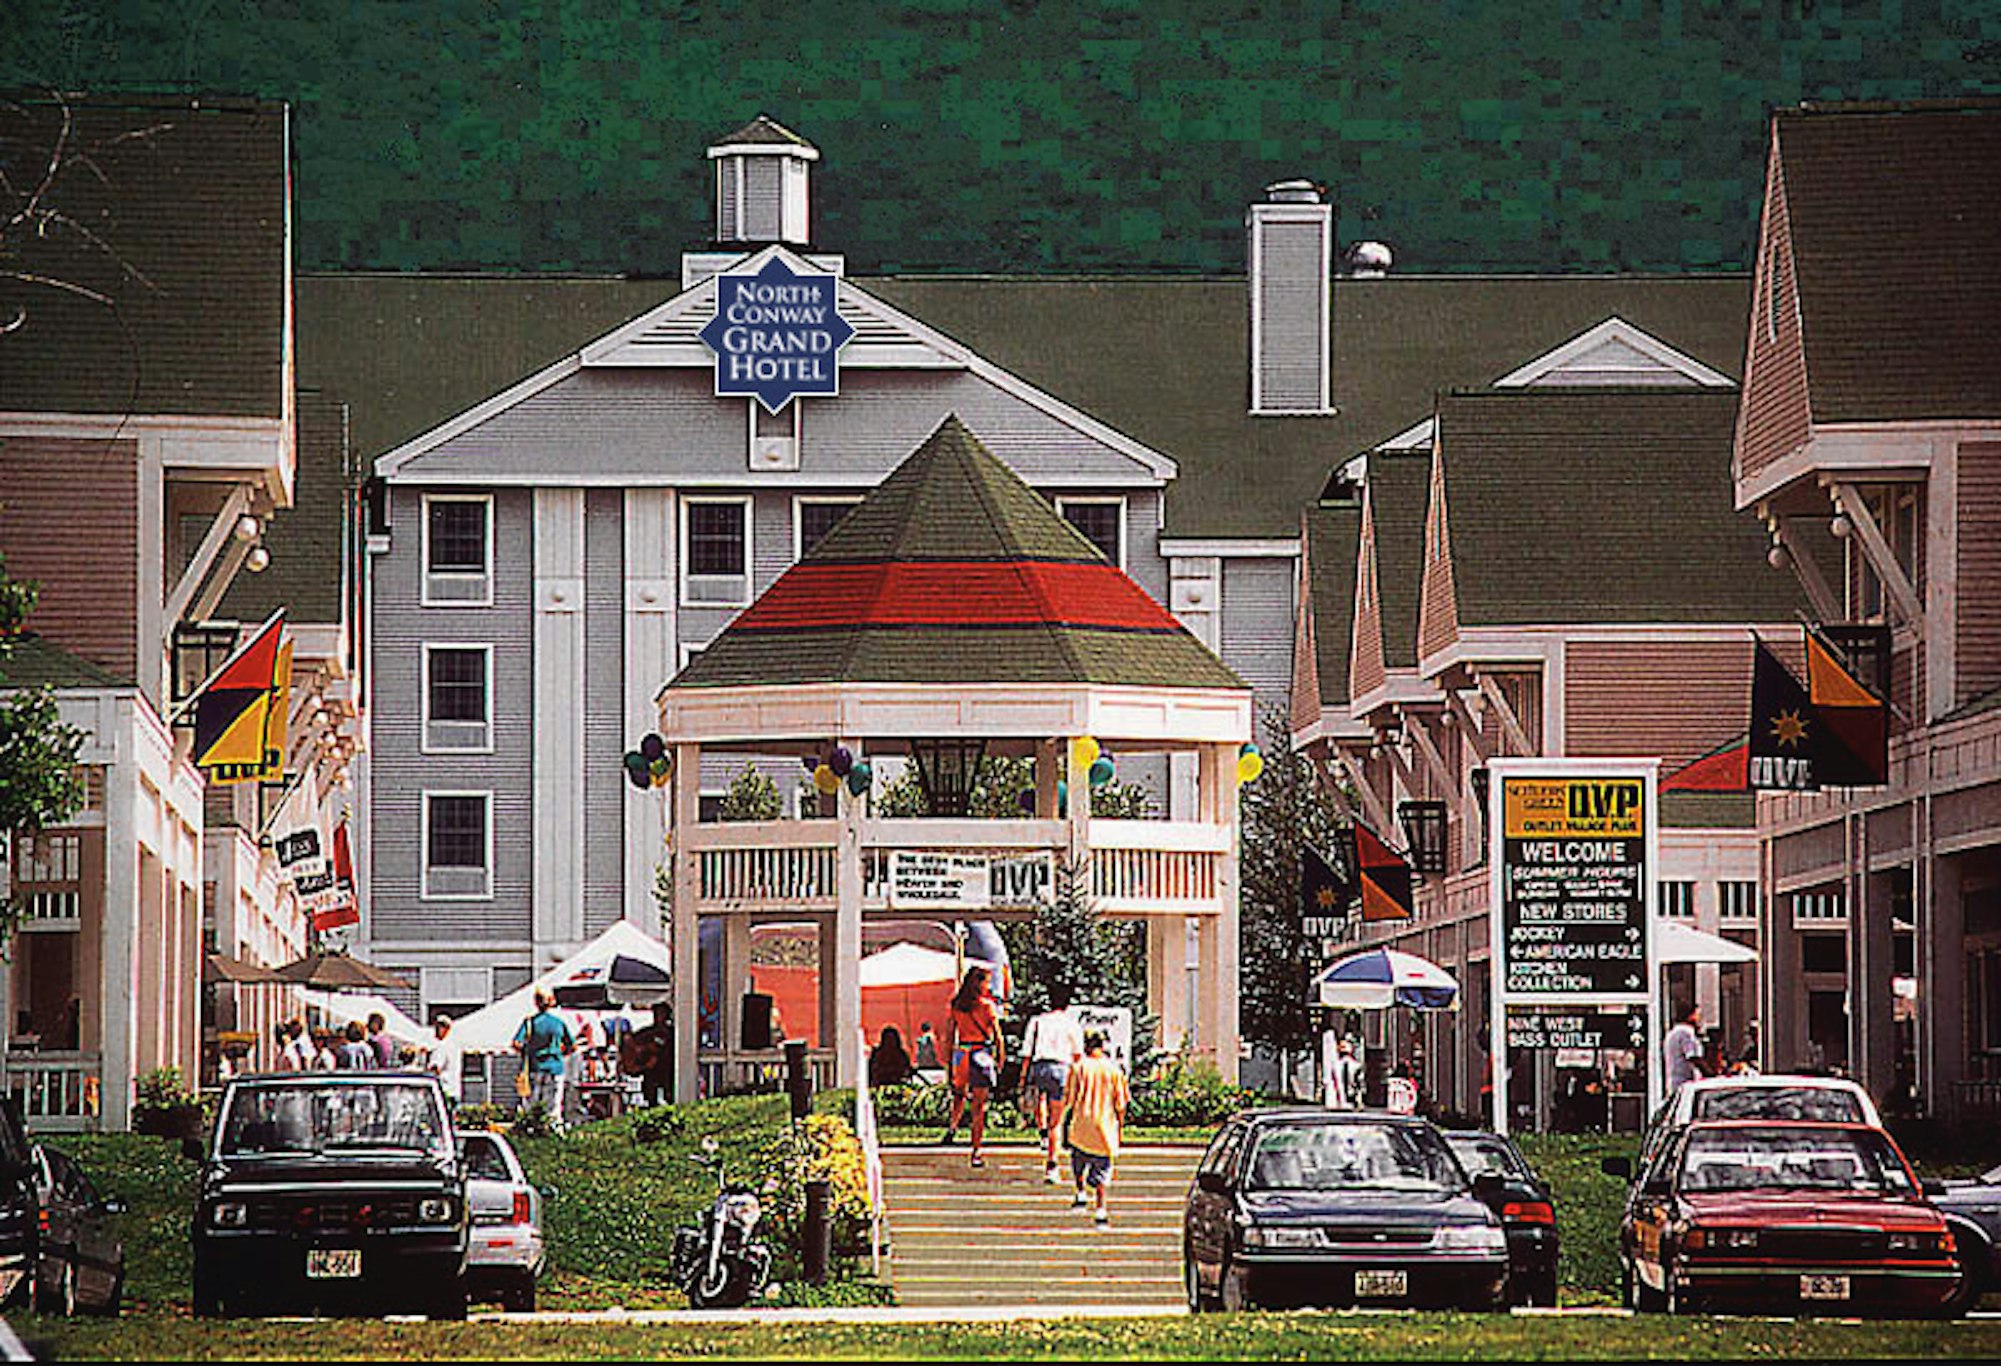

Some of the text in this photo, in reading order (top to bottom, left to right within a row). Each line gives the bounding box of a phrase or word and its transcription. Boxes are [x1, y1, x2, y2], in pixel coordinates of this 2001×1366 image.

[736, 282, 822, 304] NORTH
[727, 302, 827, 324] CONWAY
[722, 325, 832, 353] GRAND
[729, 354, 827, 381] HOTEL
[1522, 841, 1626, 862] WELCOME
[1512, 866, 1579, 880] SUMMER
[1520, 902, 1628, 920] NEW STORES
[1509, 926, 1566, 942] JOCKEY
[1524, 943, 1643, 960] AMERICAN EAGLE
[1507, 974, 1593, 992] COLLECTION
[1507, 1016, 1585, 1032] NINE WEST
[1507, 1031, 1603, 1048] BASS OUTLET
